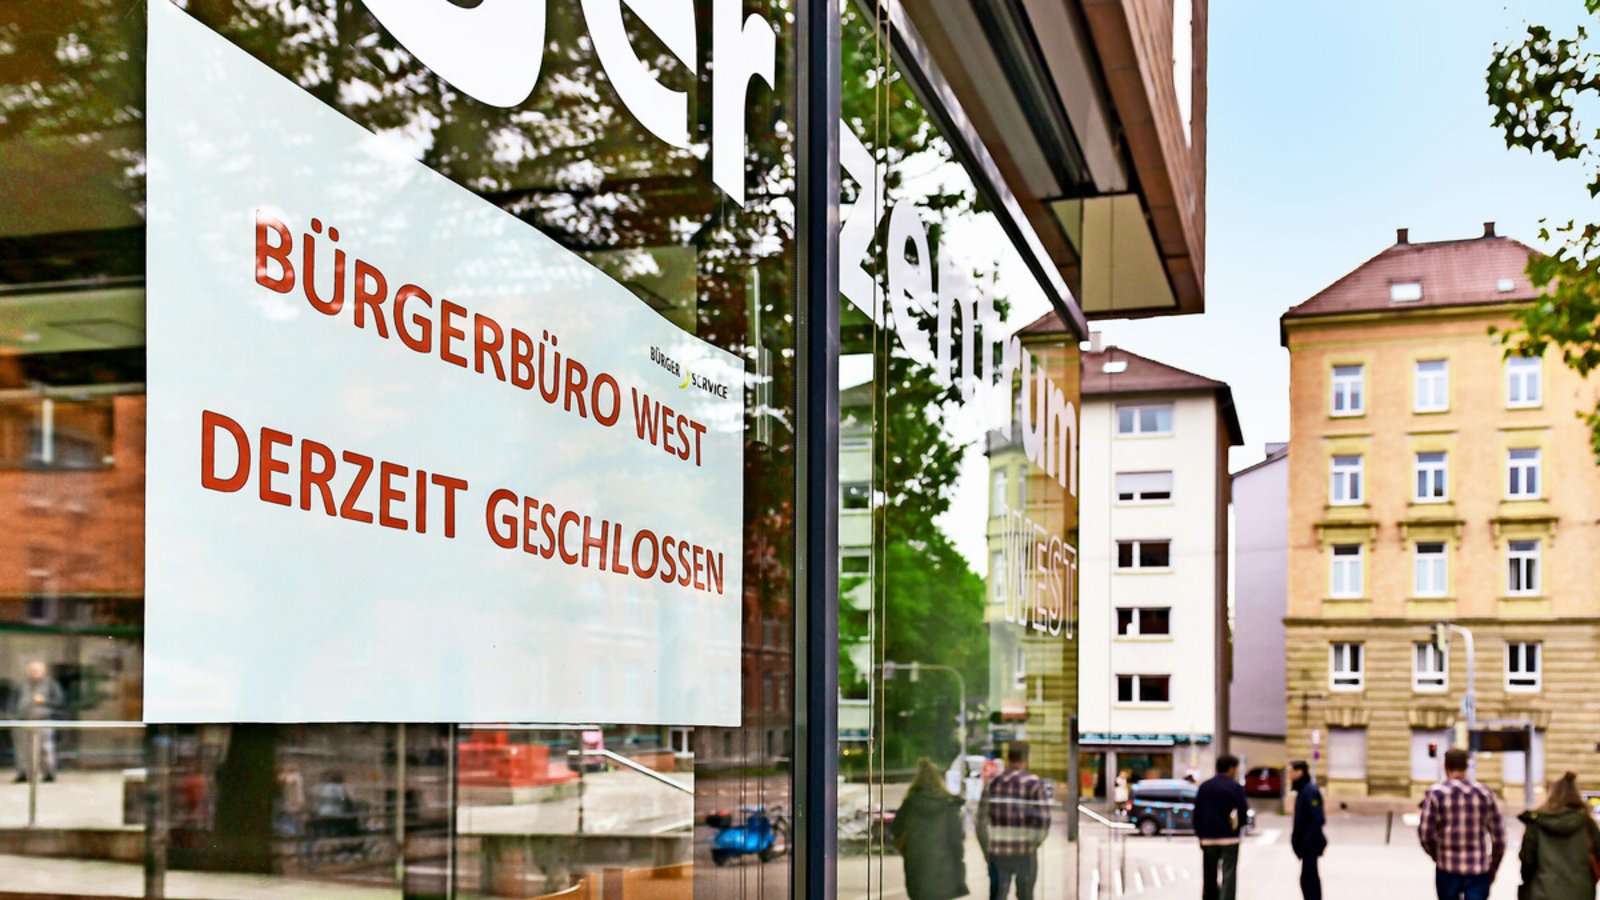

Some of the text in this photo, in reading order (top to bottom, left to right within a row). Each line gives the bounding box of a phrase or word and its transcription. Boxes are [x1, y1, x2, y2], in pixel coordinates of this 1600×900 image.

[255, 208, 708, 467] BÜRGERBÜRO WEST
[650, 345, 681, 378] BÜRGER
[201, 409, 724, 596] DERZEIT GESCHLOSSEN
[1001, 504, 1077, 640] WEST
